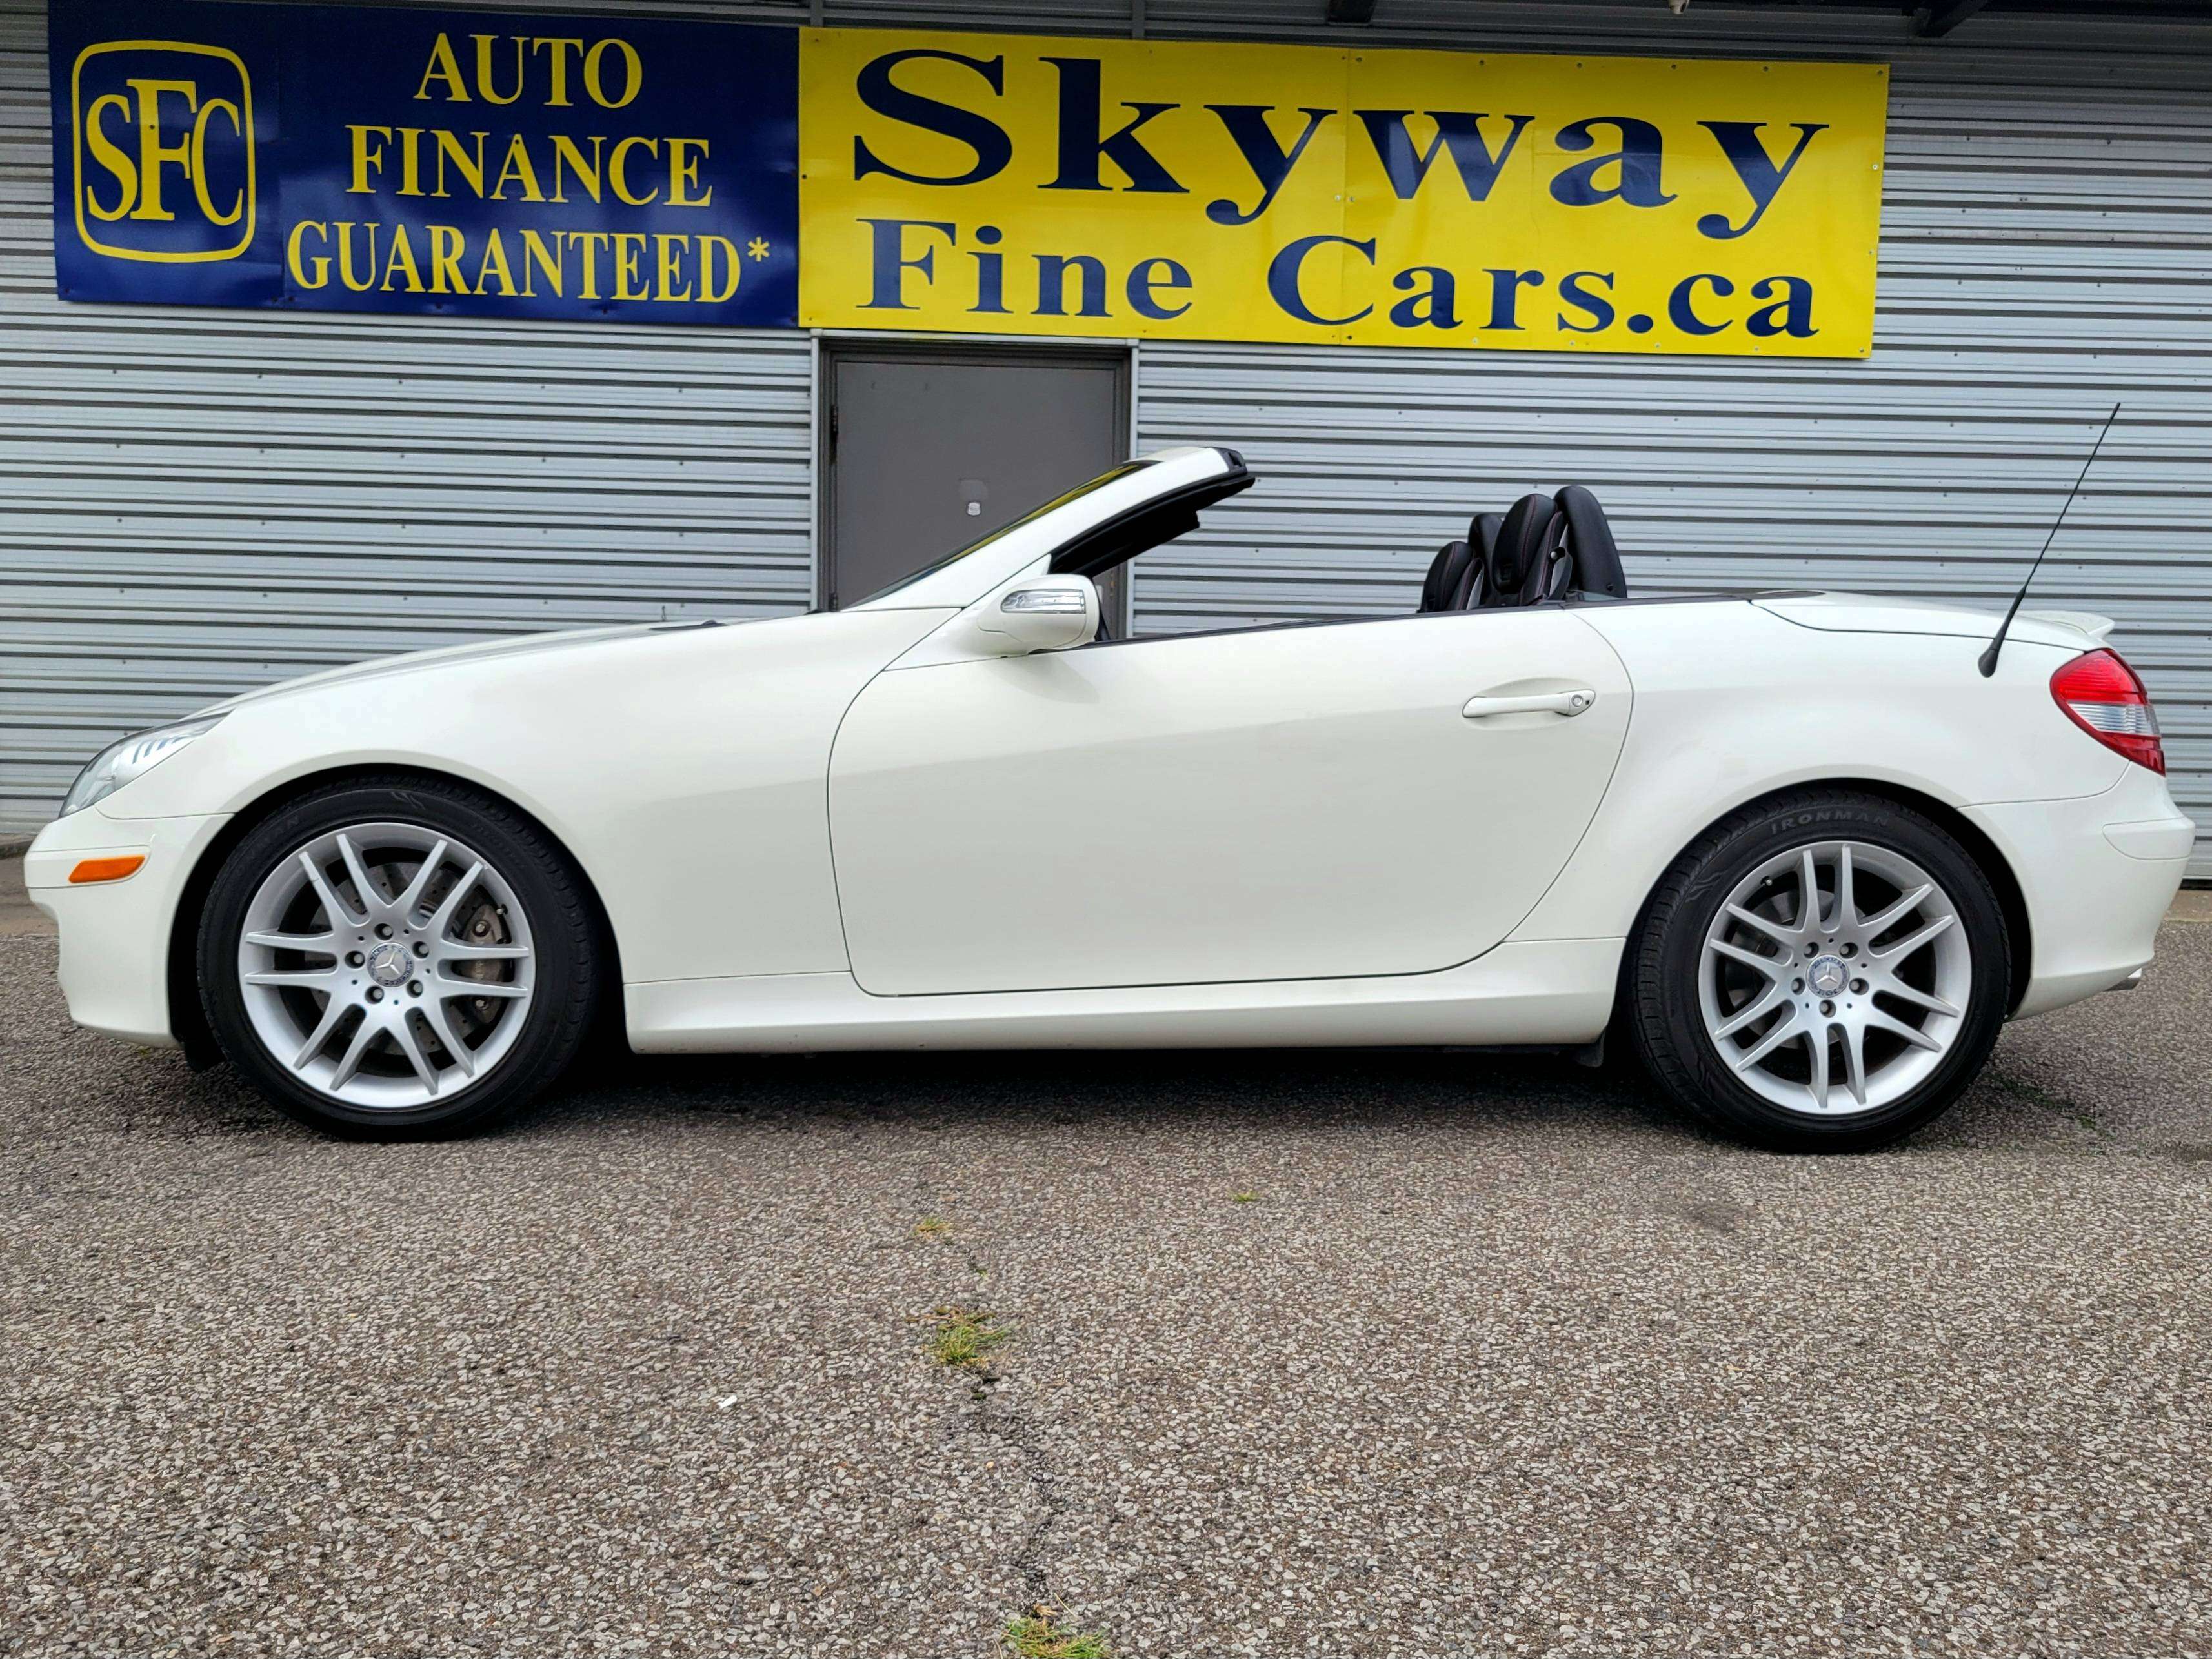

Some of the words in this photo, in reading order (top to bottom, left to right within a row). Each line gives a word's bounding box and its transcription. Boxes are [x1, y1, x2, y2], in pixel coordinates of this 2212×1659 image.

[413, 32, 643, 108] AUTO
[86, 79, 243, 226] SFC
[345, 125, 712, 206] FINANCE
[854, 49, 1830, 239] Skyway
[856, 218, 1193, 320] Fine
[1267, 235, 1819, 339] Cars.ca
[1771, 810, 1890, 835] IRONMAN
